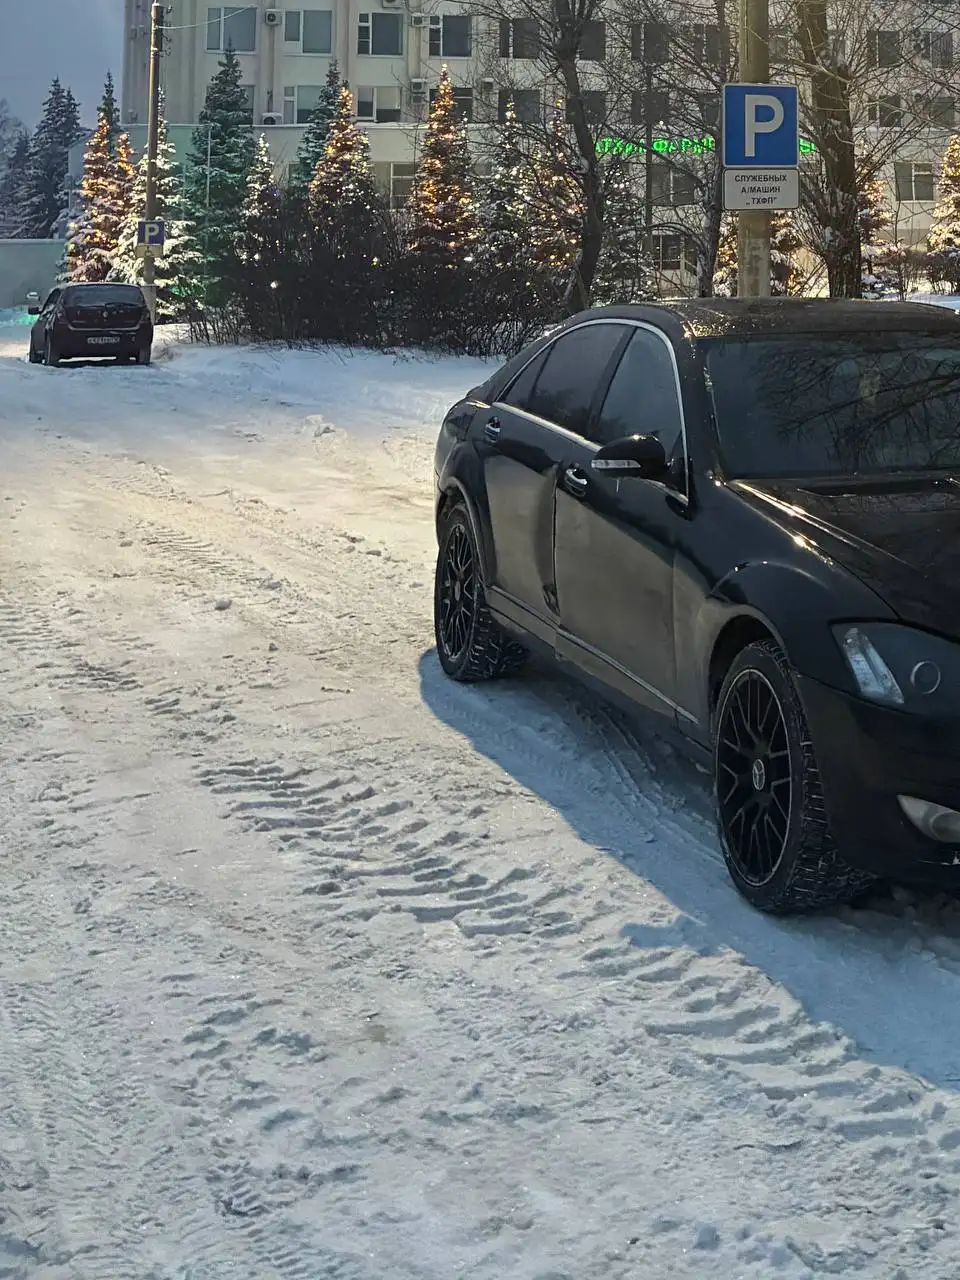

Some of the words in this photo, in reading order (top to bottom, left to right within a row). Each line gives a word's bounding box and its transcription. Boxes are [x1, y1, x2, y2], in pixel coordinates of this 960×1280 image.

[744, 94, 785, 157] P
[734, 174, 788, 183] СЛУЖЕБНЫХ
[144, 222, 160, 243] P
